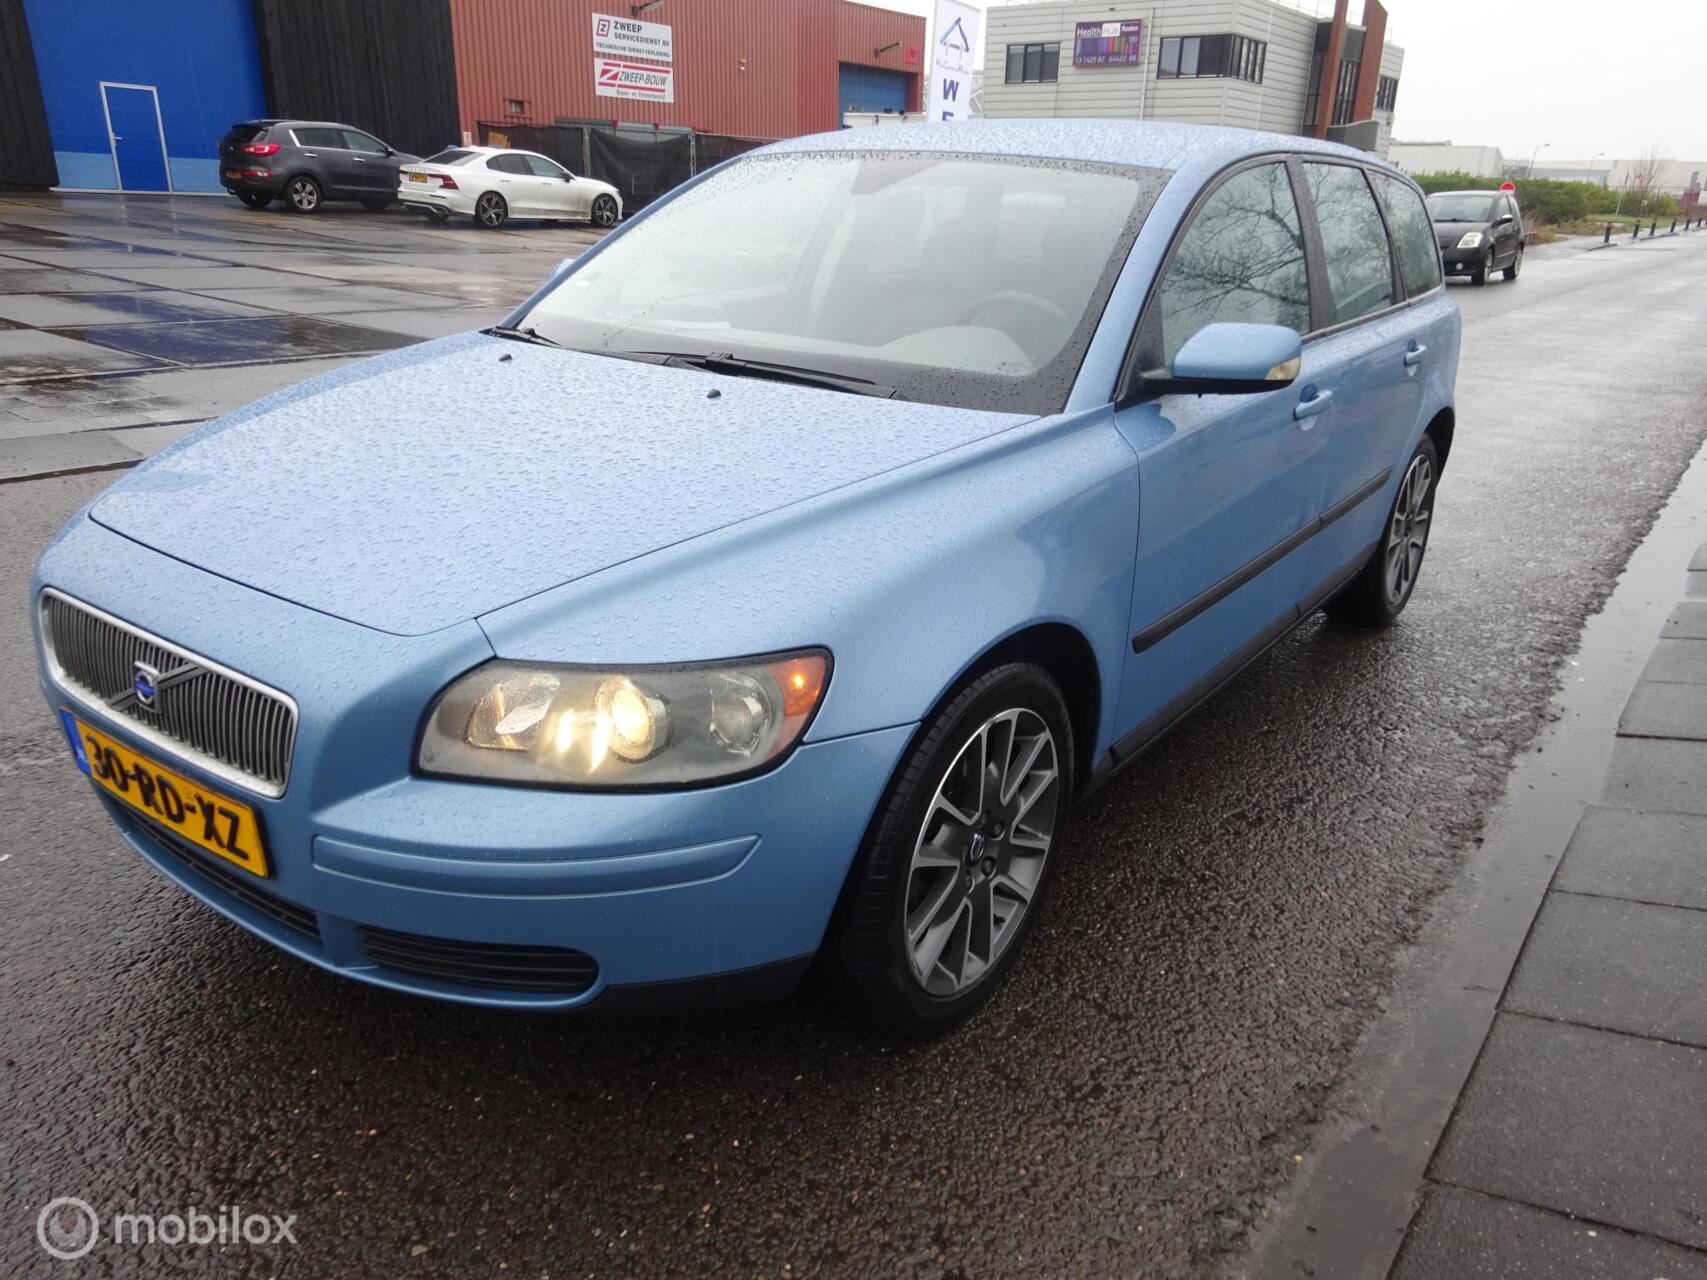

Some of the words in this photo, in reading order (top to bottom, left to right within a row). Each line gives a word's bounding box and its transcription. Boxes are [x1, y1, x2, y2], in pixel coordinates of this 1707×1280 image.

[613, 21, 642, 32] ZWEEP
[1077, 27, 1102, 38] Health
[614, 33, 661, 46] SERVICEDIENST
[596, 42, 627, 52] TECHNISCHE
[628, 46, 670, 58] DIENSTVERLENING
[618, 71, 668, 86] ZWEEP-BOUW
[86, 734, 249, 861] 30-RD-XZ
